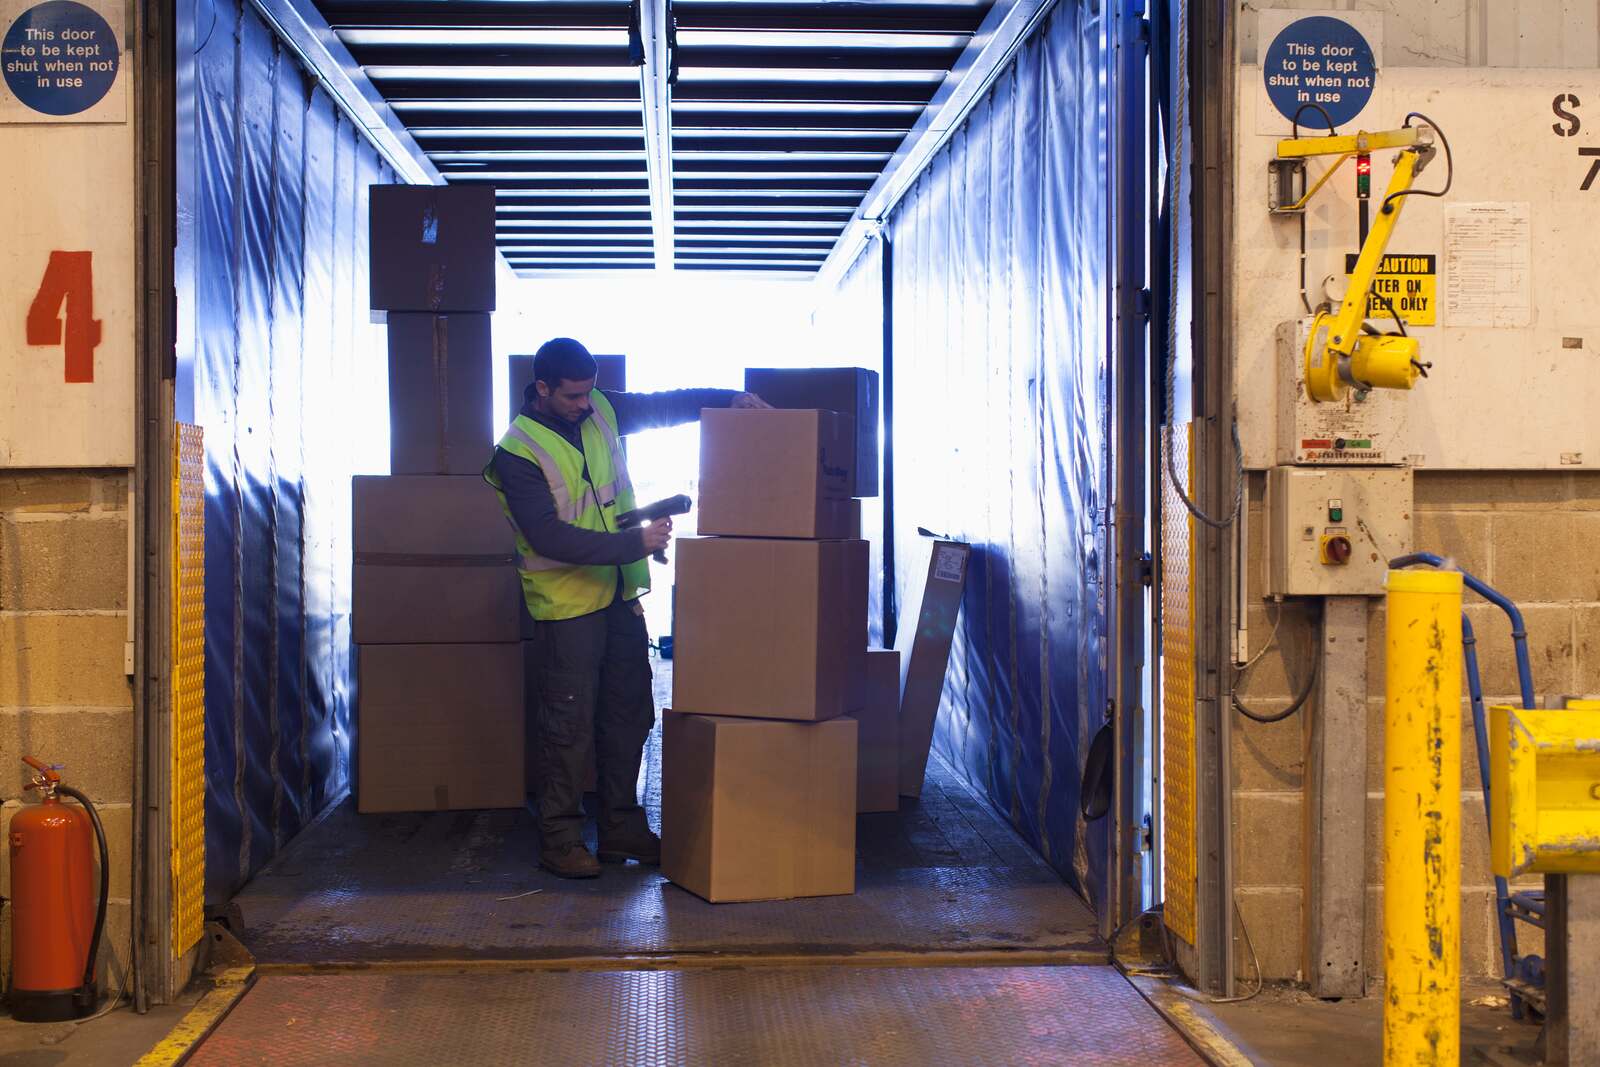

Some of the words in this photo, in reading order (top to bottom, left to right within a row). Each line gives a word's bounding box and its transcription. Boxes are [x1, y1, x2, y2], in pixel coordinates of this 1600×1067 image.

[25, 28, 54, 40] This
[61, 28, 96, 40] door
[20, 44, 35, 56] to
[42, 44, 60, 56] be
[67, 44, 100, 58] kept
[1286, 43, 1315, 56] This
[1321, 44, 1354, 56] door
[7, 60, 38, 72] shut
[45, 60, 83, 72] when
[89, 60, 114, 72] not
[1282, 59, 1296, 71] to
[1302, 60, 1320, 71] be
[1326, 60, 1358, 74] kept
[37, 75, 50, 87] in
[56, 77, 83, 87] use
[1269, 74, 1299, 86] shut
[1305, 75, 1341, 87] when
[1347, 76, 1370, 88] not
[1297, 90, 1310, 102] in
[1315, 92, 1341, 103] use
[1552, 93, 1581, 137] S
[1578, 147, 1600, 191] 7
[1407, 279, 1422, 293] ON
[1401, 297, 1428, 311] ONLY
[26, 250, 103, 384] 4
